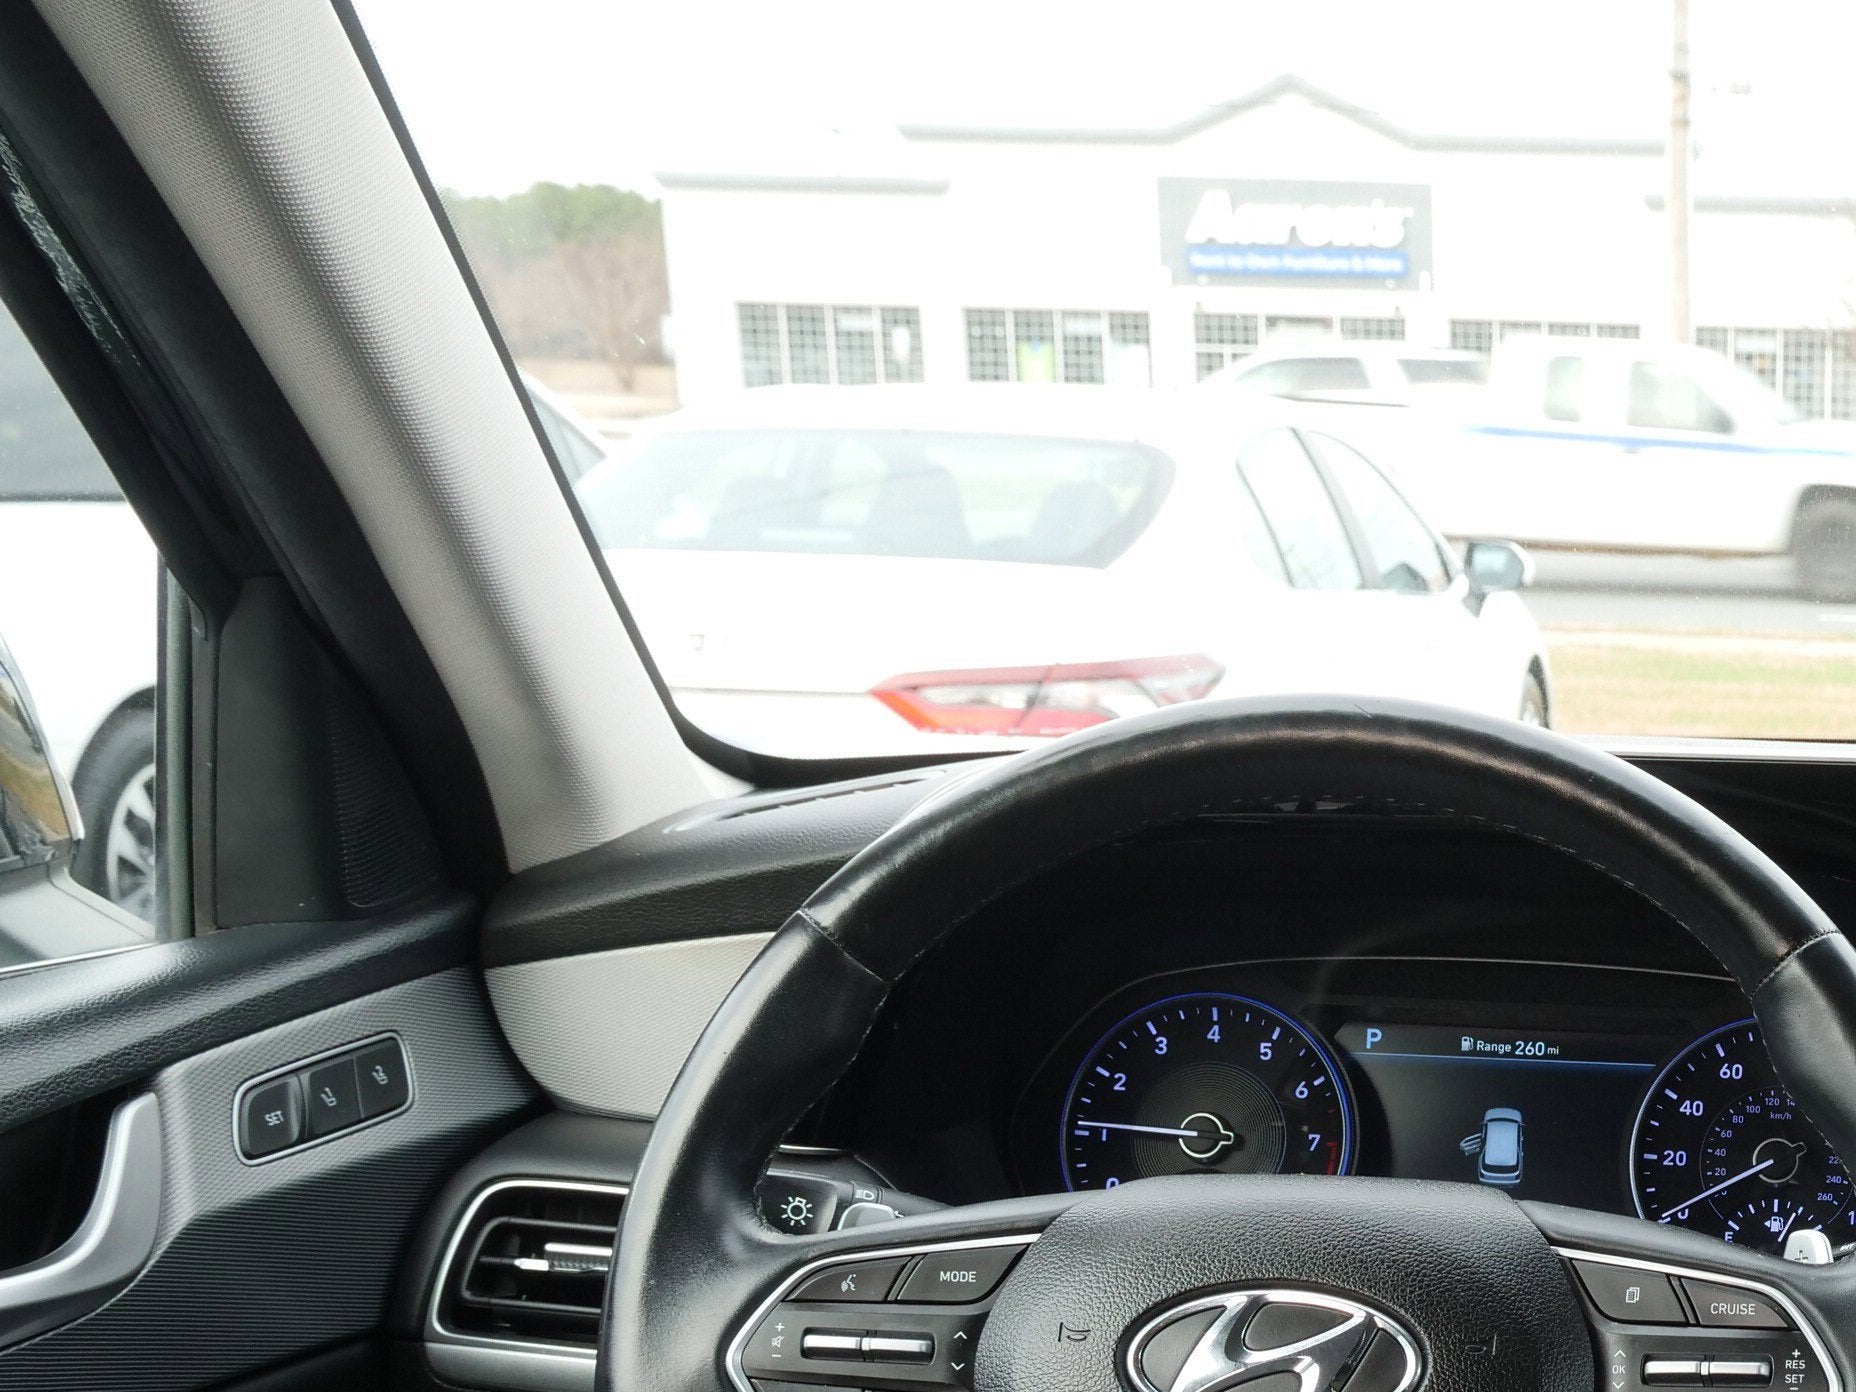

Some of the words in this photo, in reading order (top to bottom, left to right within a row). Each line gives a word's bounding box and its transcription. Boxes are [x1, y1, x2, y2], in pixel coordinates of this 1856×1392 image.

[1207, 1024, 1220, 1043] 4
[1365, 1028, 1382, 1049] P
[1155, 1036, 1168, 1055] 3
[1259, 1042, 1273, 1061] 5
[1477, 1040, 1511, 1053] Range
[1515, 1041, 1545, 1056] 260
[1547, 1046, 1559, 1055] mi
[1719, 1063, 1743, 1080] 60
[1113, 1072, 1127, 1091] 2
[1295, 1081, 1309, 1099] 6
[1765, 1097, 1780, 1106] 120
[1679, 1100, 1704, 1117] 40
[1746, 1105, 1761, 1114] 100
[264, 1110, 284, 1127] SET
[1732, 1115, 1744, 1124] 80
[1770, 1112, 1792, 1121] km/h
[1720, 1130, 1732, 1138] 60
[1308, 1133, 1321, 1151] 7
[1662, 1150, 1686, 1167] 20
[1714, 1148, 1726, 1157] 40
[1714, 1167, 1726, 1176] 20
[1826, 1175, 1842, 1184] 240
[1817, 1193, 1833, 1201] 260
[939, 1270, 977, 1283] MODE
[1710, 1303, 1756, 1315] CRUISE
[1612, 1364, 1626, 1374] OK
[1785, 1359, 1805, 1369] RES
[1784, 1374, 1804, 1384] SET
